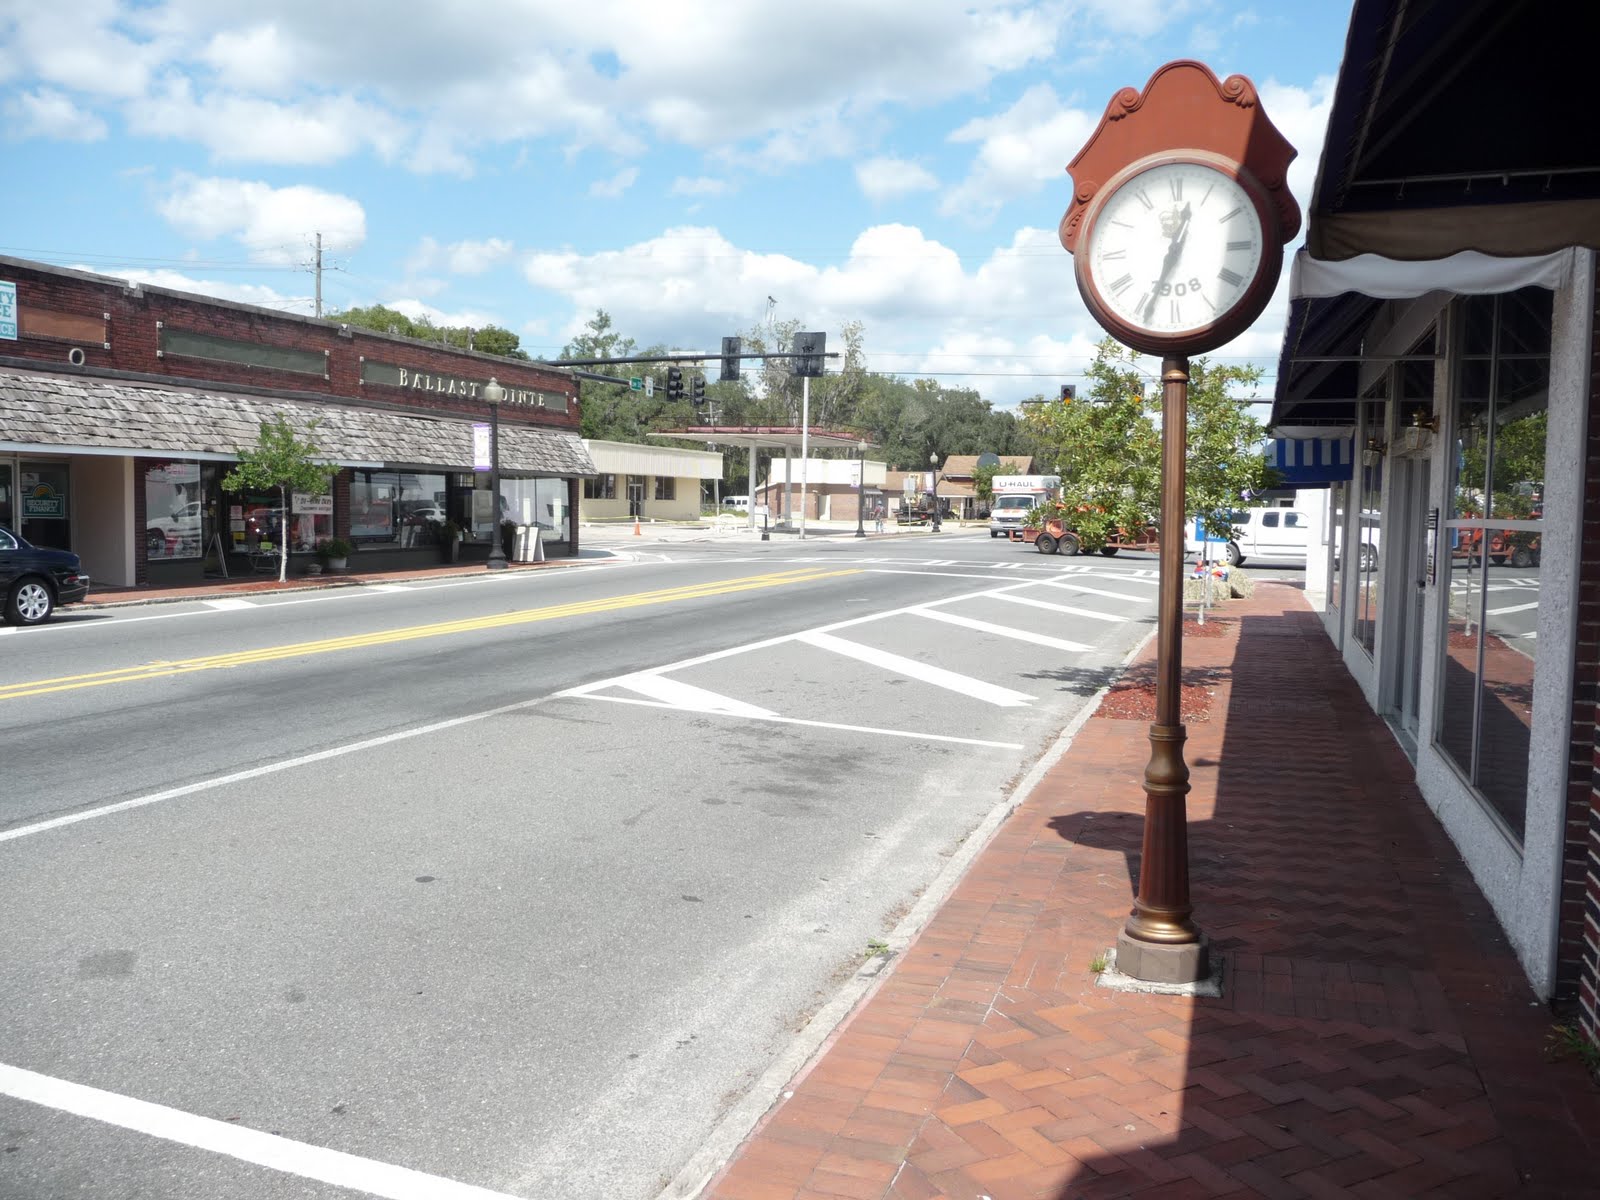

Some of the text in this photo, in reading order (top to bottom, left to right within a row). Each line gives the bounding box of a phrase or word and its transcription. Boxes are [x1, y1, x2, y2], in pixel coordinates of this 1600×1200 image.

[1151, 276, 1202, 297] 1908
[399, 367, 545, 406] BALLAST OINTE
[26, 499, 59, 507] SECURITY
